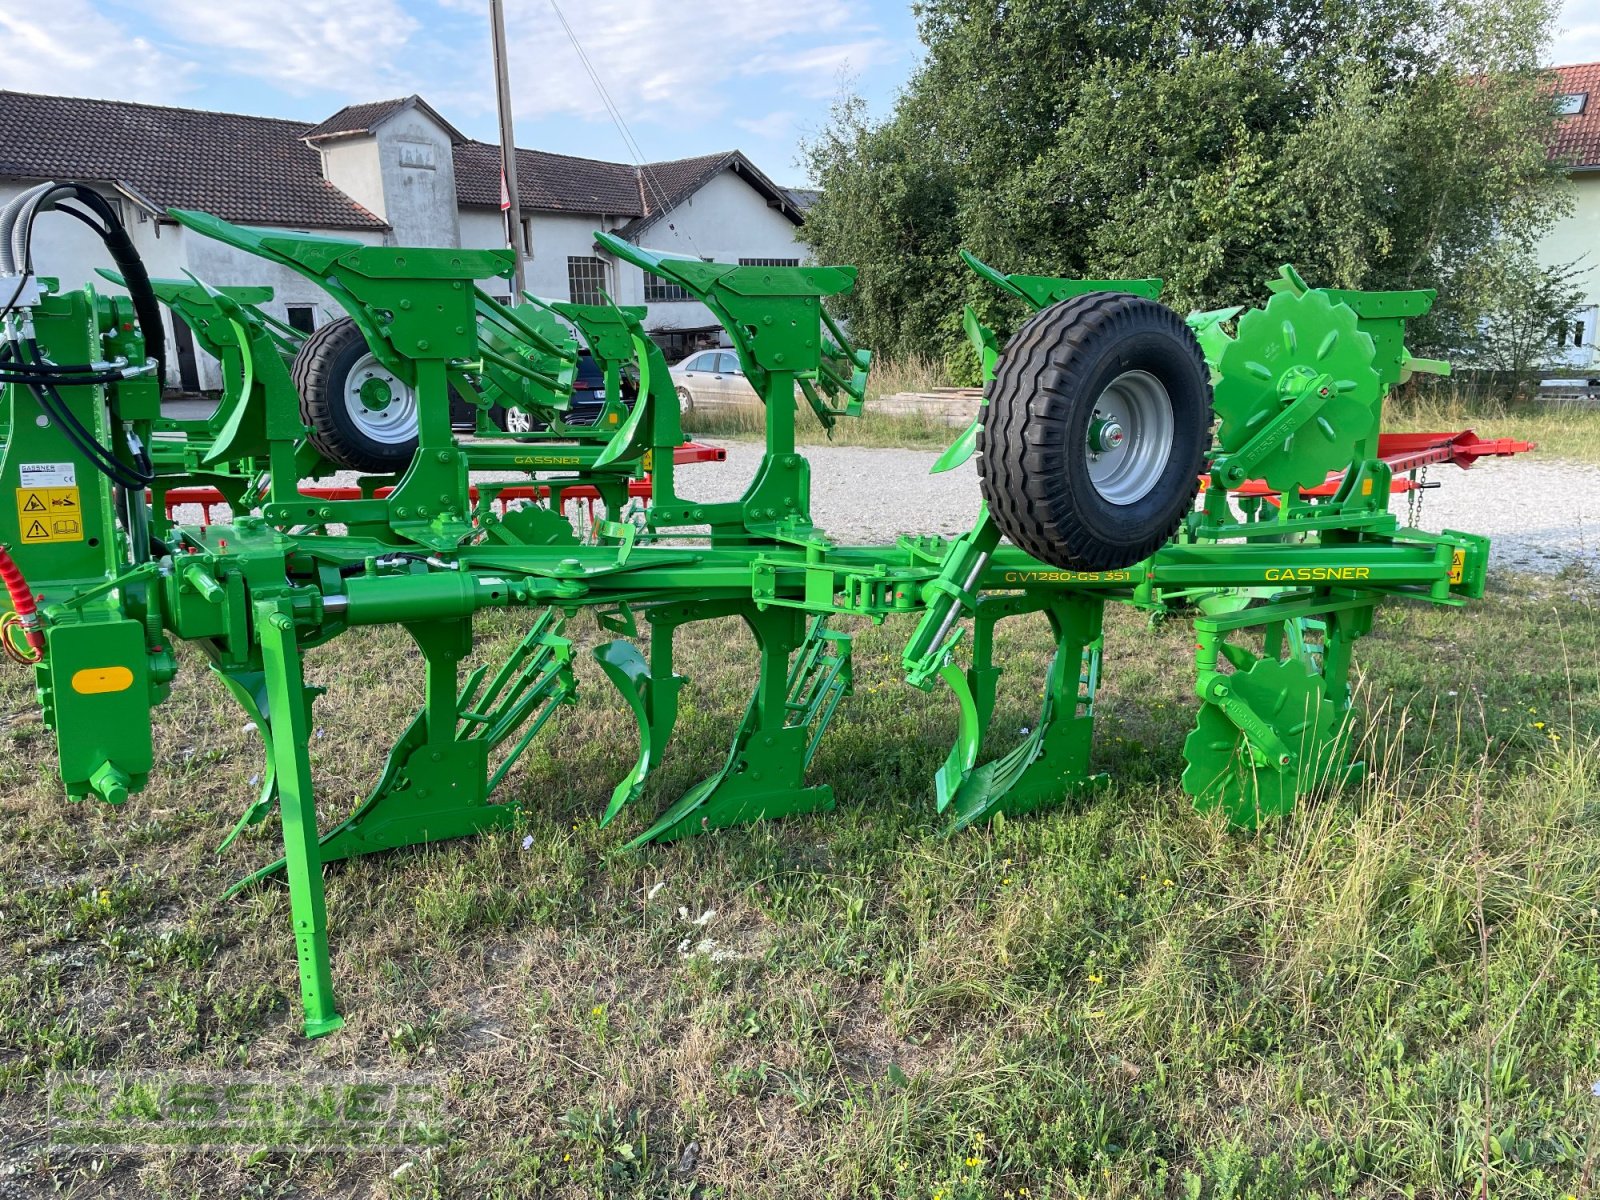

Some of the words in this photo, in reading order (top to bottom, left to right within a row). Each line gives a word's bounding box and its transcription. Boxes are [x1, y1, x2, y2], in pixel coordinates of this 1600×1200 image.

[514, 456, 580, 465] GASSNER
[1004, 571, 1099, 583] GV1280-GS
[1103, 571, 1131, 582] 351
[1265, 567, 1370, 581] GASSNER
